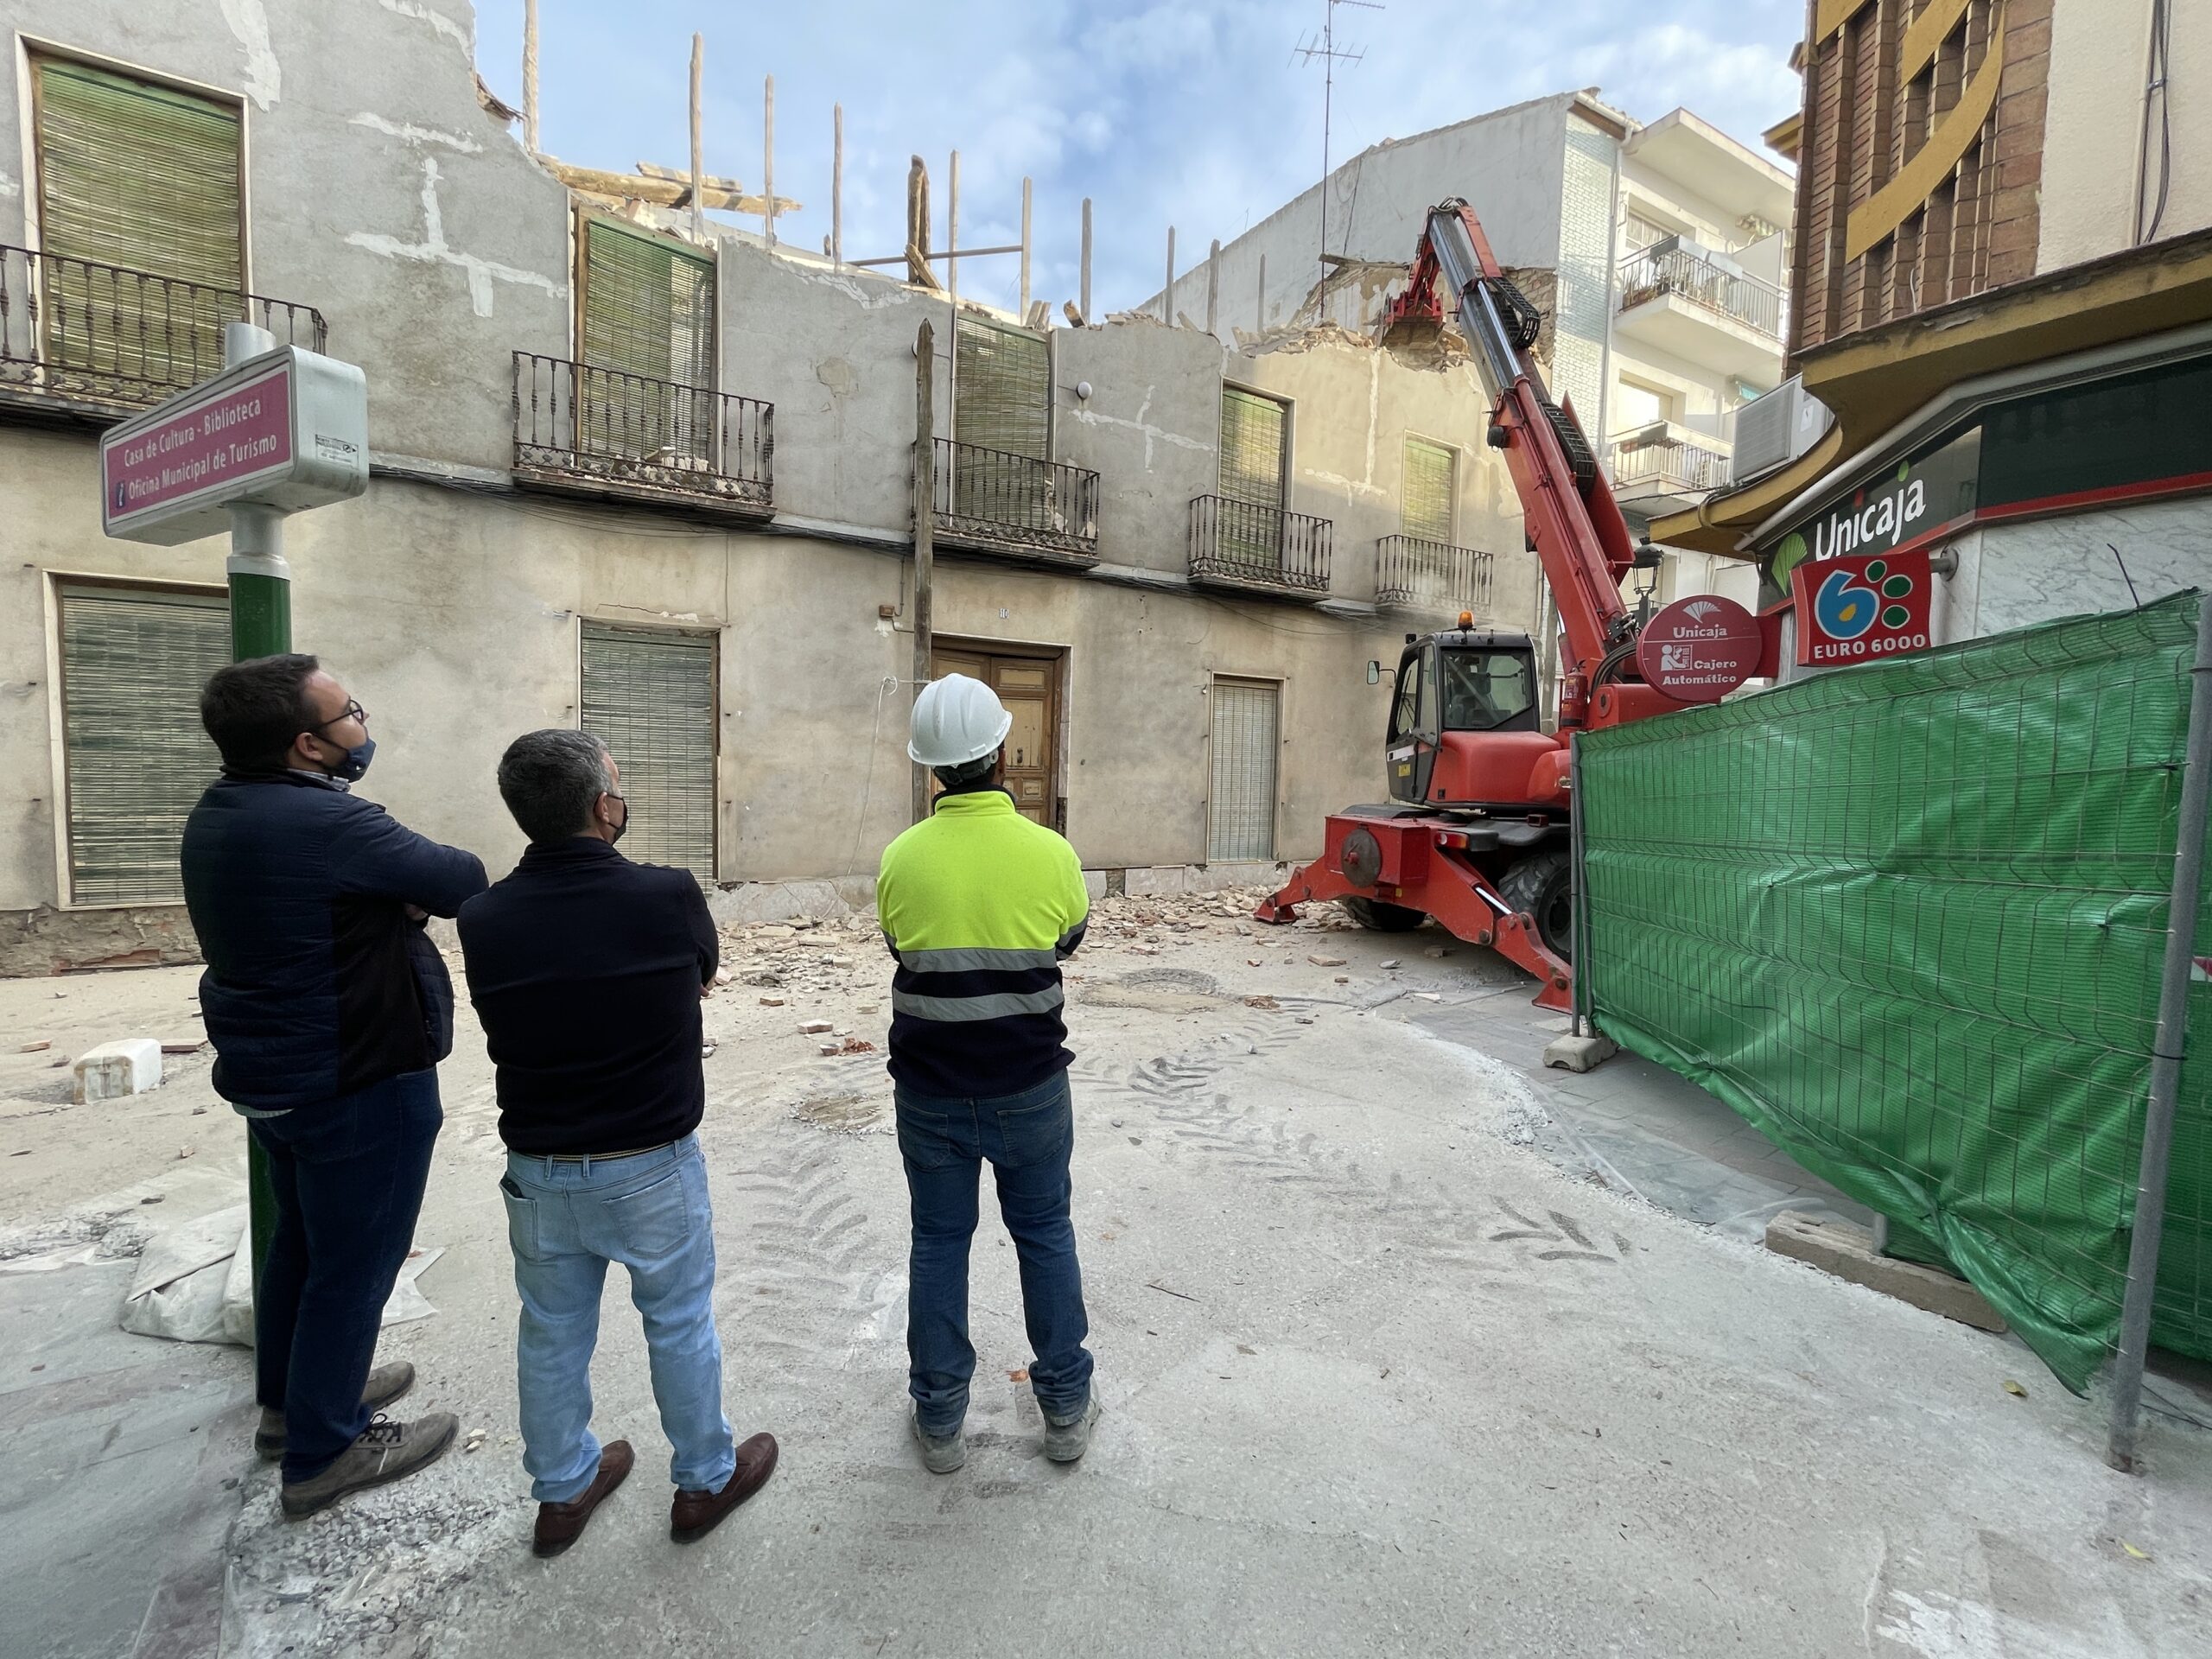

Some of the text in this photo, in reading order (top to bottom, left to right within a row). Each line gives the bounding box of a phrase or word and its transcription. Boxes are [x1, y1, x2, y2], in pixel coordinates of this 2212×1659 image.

[124, 449, 143, 467] Casa
[146, 439, 157, 459] de
[159, 427, 194, 453] Cultura
[204, 399, 261, 435] Biblioteca
[129, 475, 160, 499] Oficina
[162, 452, 210, 489] Municipal
[213, 448, 226, 470] de
[229, 435, 276, 464] Turismo
[1815, 461, 1926, 562] Unicaja
[1673, 624, 1727, 639] Unicaja
[1815, 633, 1926, 659] EURO 6000
[1694, 659, 1738, 671] Cajero
[1662, 674, 1737, 685] Automático
